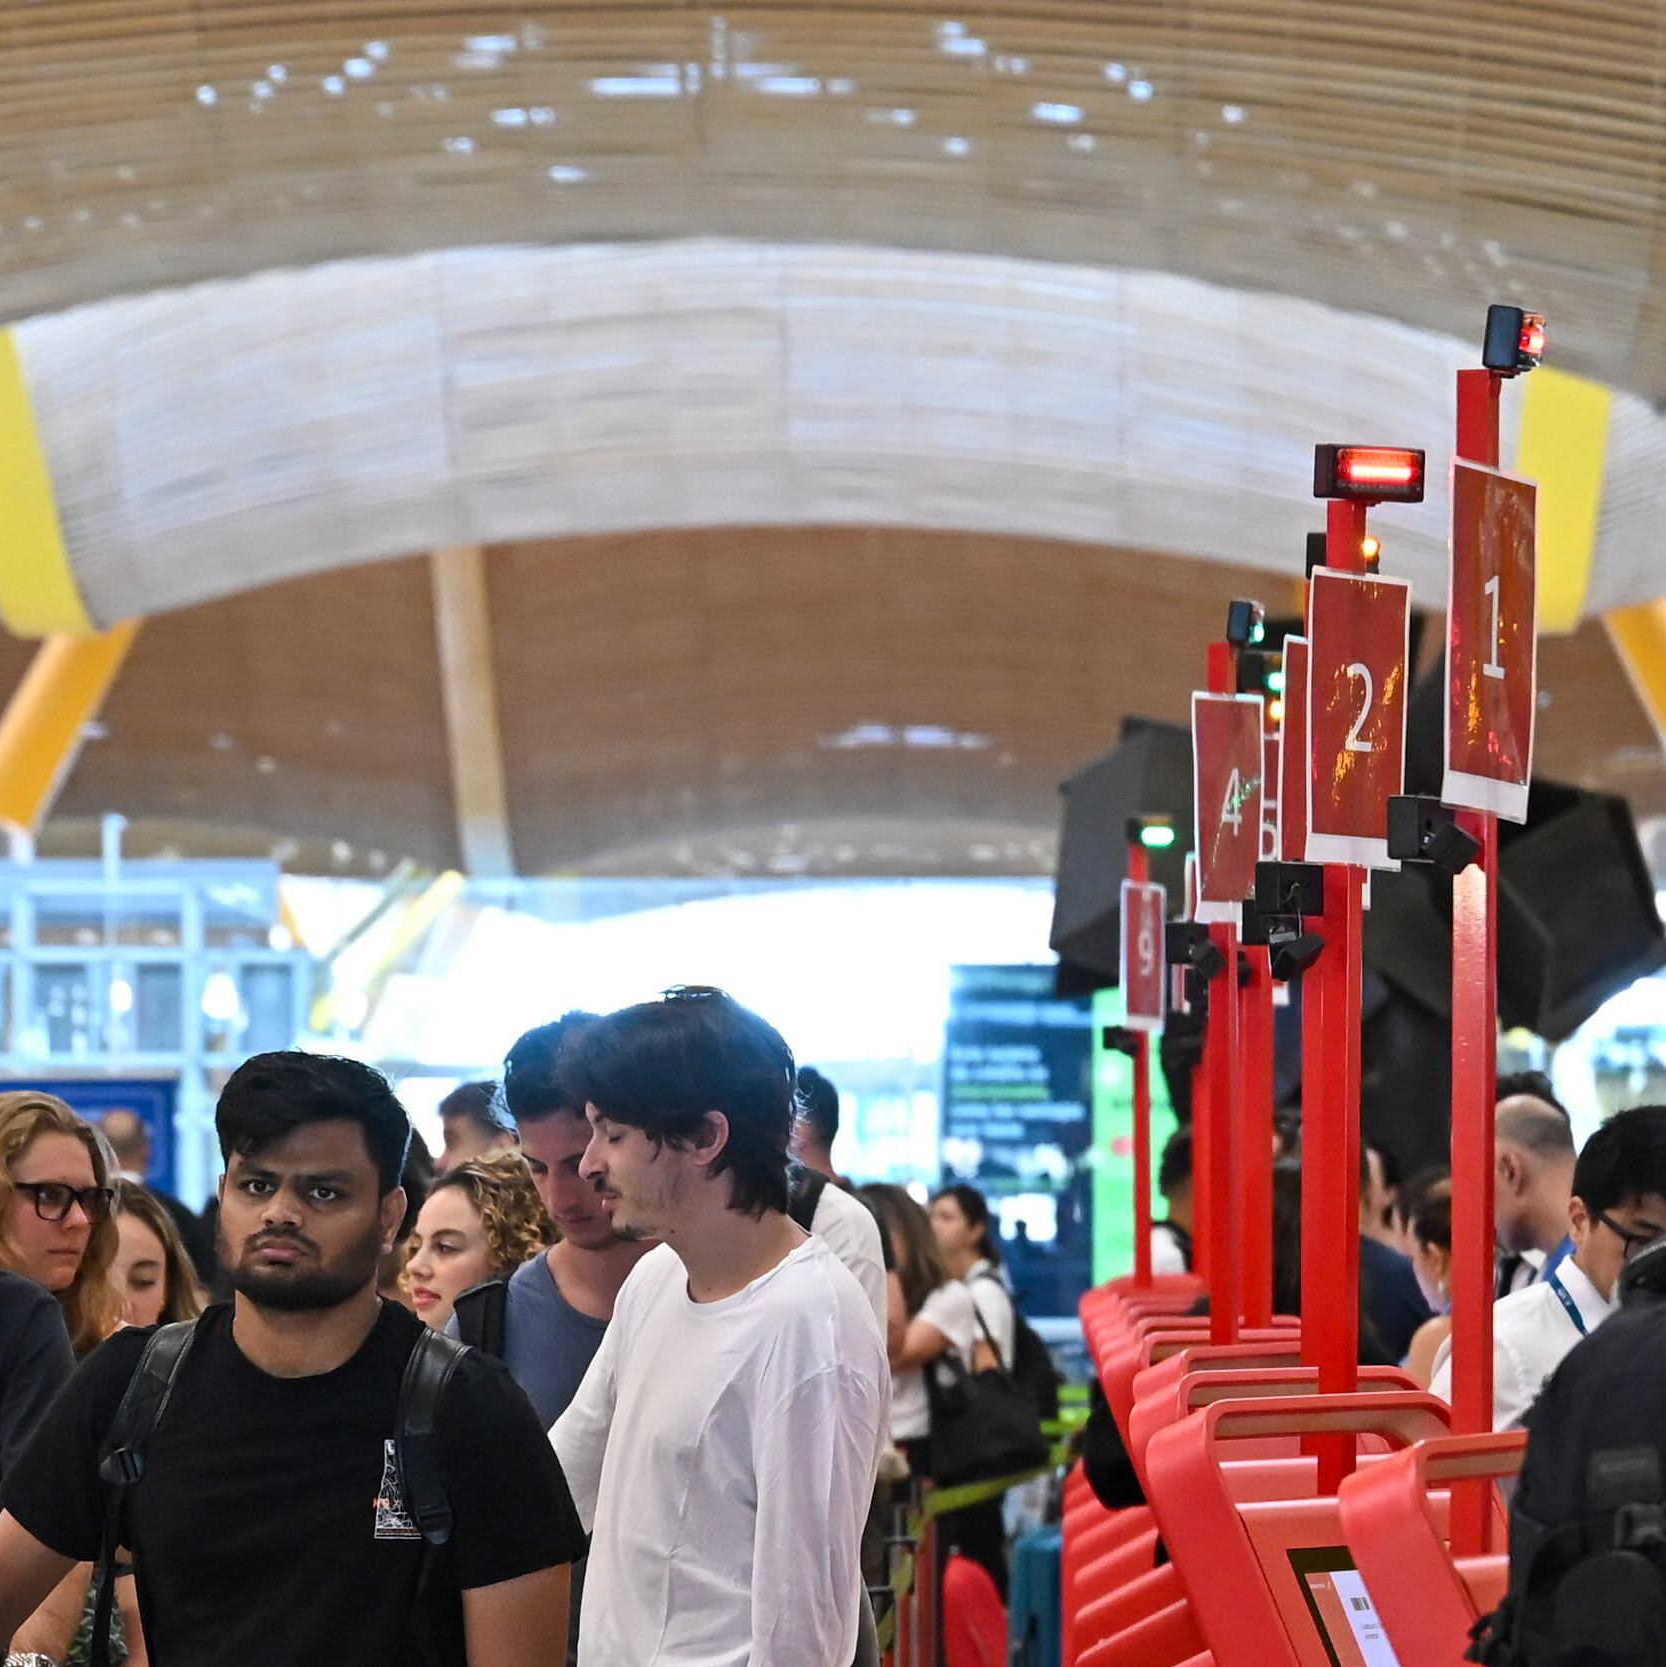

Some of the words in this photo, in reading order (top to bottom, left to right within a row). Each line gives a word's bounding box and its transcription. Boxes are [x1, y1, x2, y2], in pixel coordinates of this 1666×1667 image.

[1483, 575, 1505, 680] 1
[1345, 662, 1373, 752] 2
[1221, 767, 1243, 837] 4
